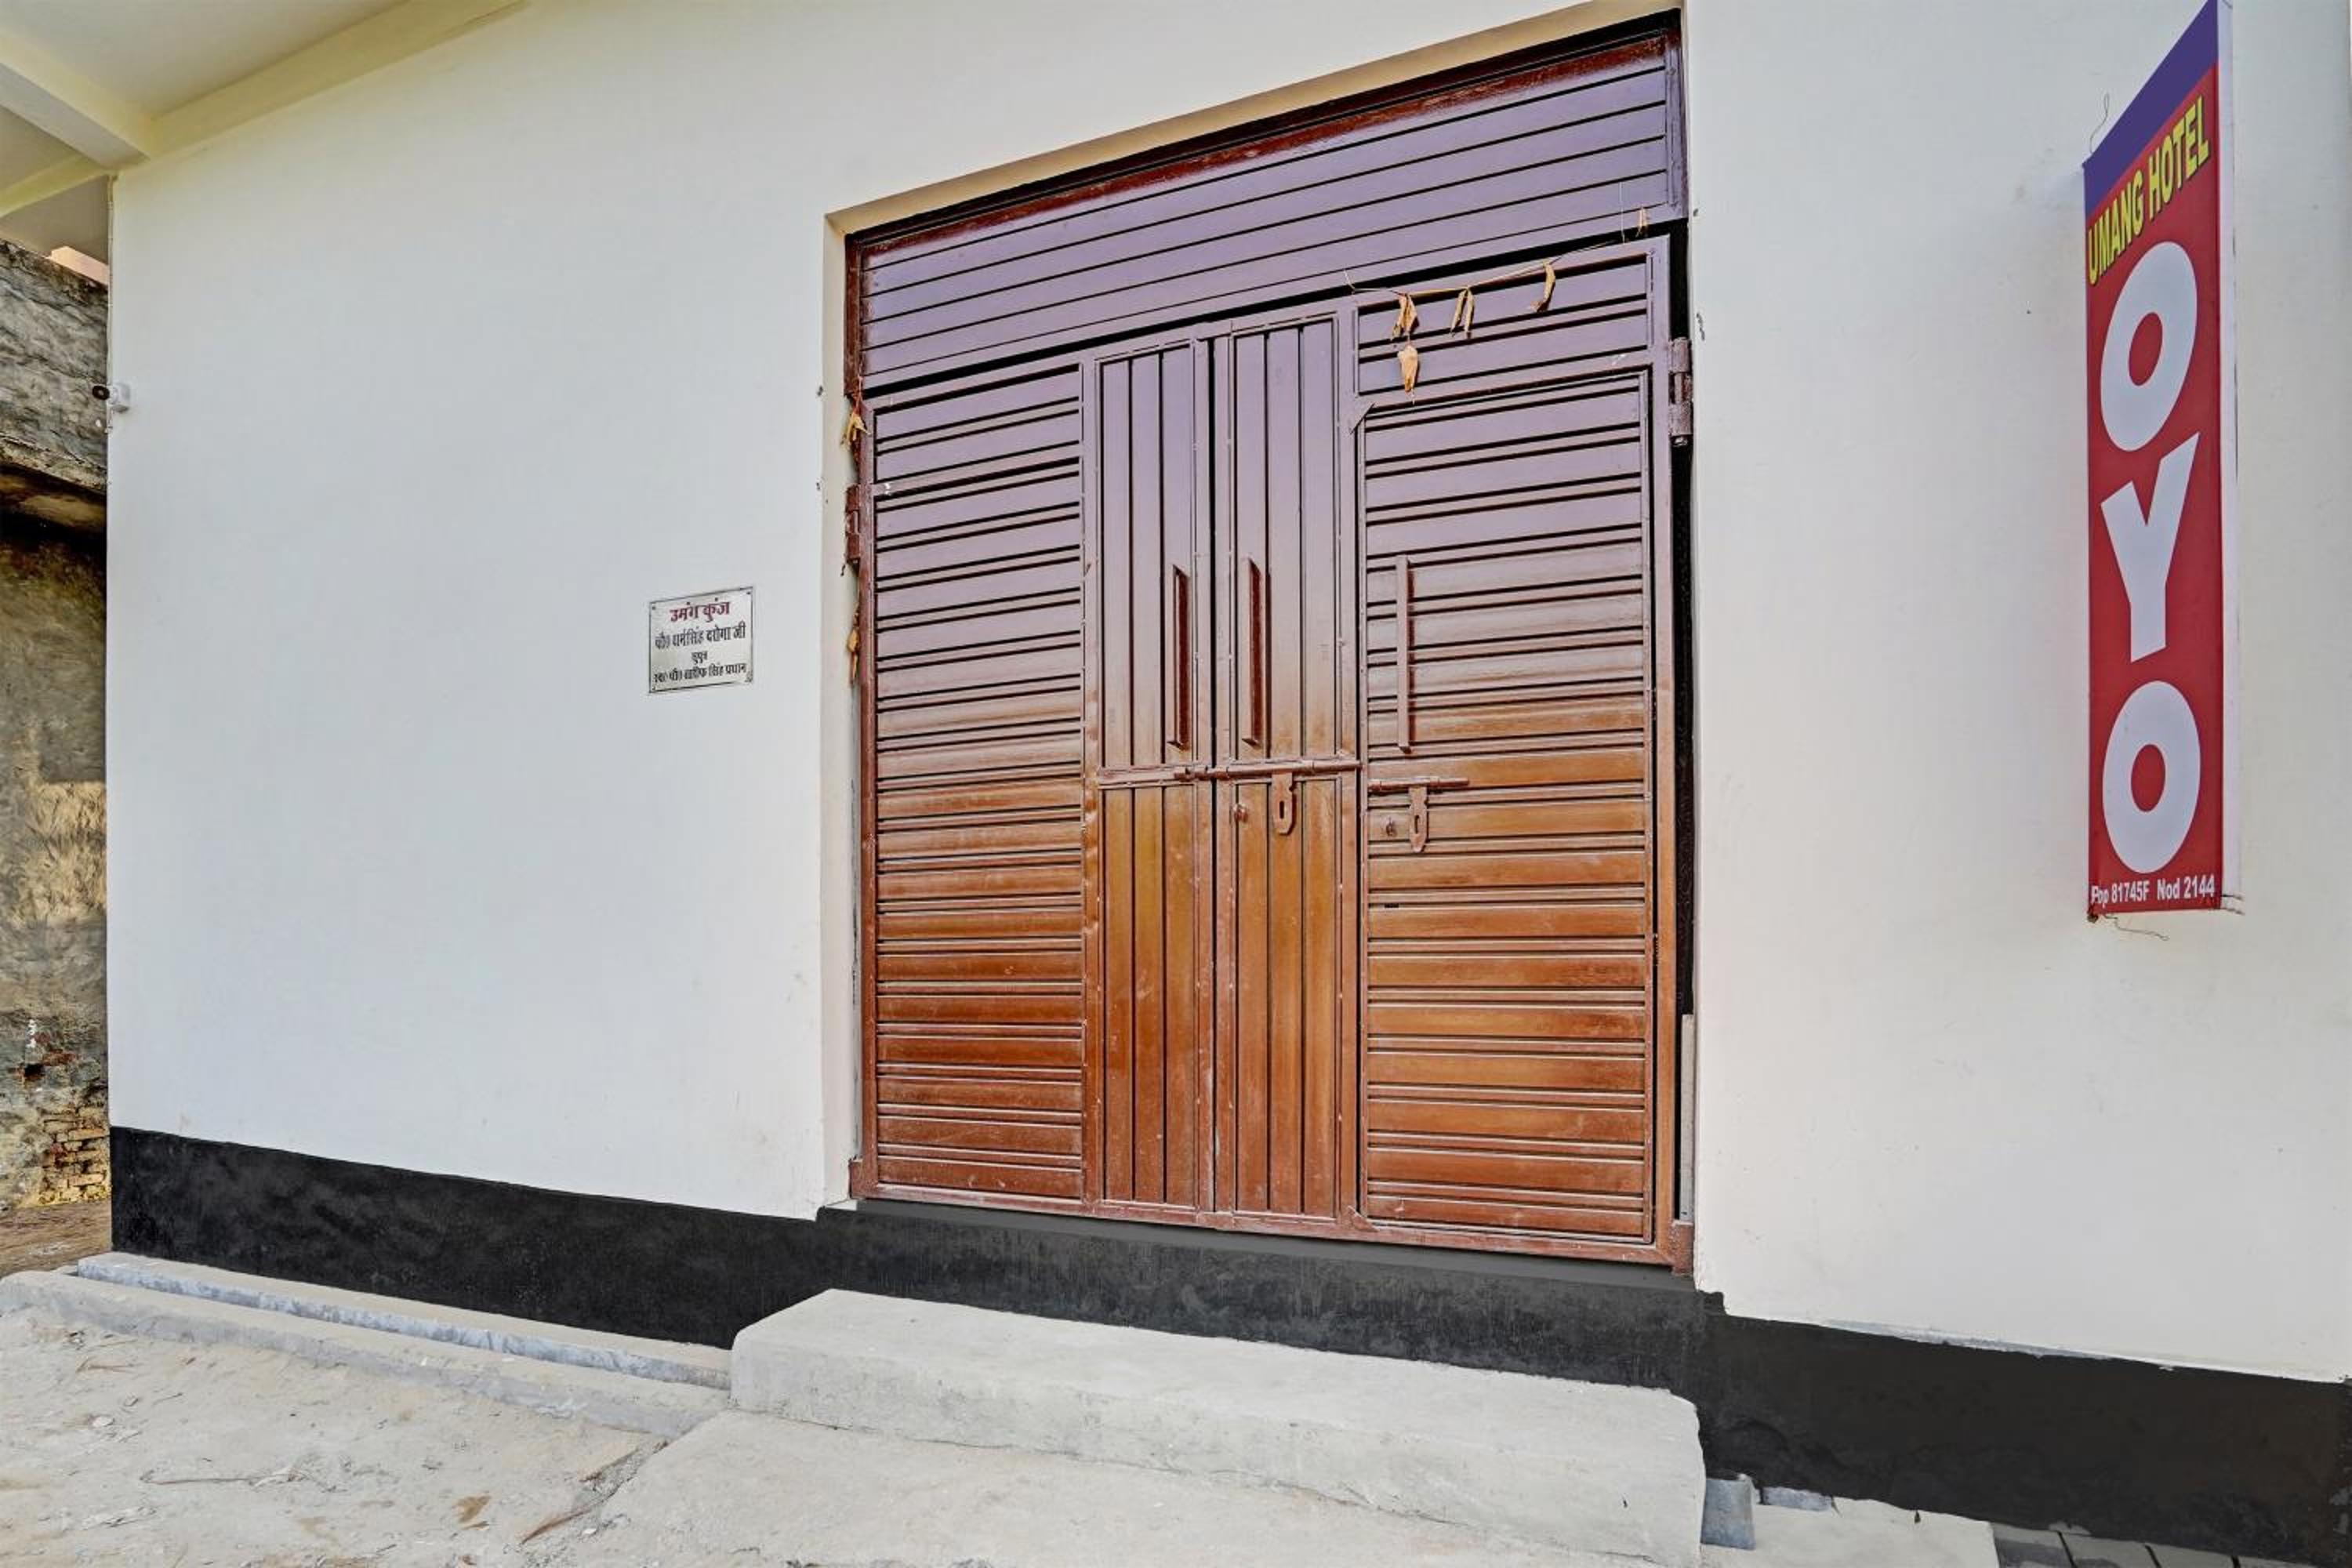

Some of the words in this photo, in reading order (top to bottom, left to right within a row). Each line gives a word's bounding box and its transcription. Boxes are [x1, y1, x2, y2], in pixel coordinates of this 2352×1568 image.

[2088, 169, 2144, 285] UMANG
[2147, 96, 2210, 221] HOTEL
[670, 601, 699, 622] उमंग
[702, 597, 731, 622] कुंज
[2100, 241, 2201, 873] OYO
[2111, 880, 2151, 904] 81745F
[2157, 877, 2180, 901] Nod
[2183, 874, 2216, 899] 2144
